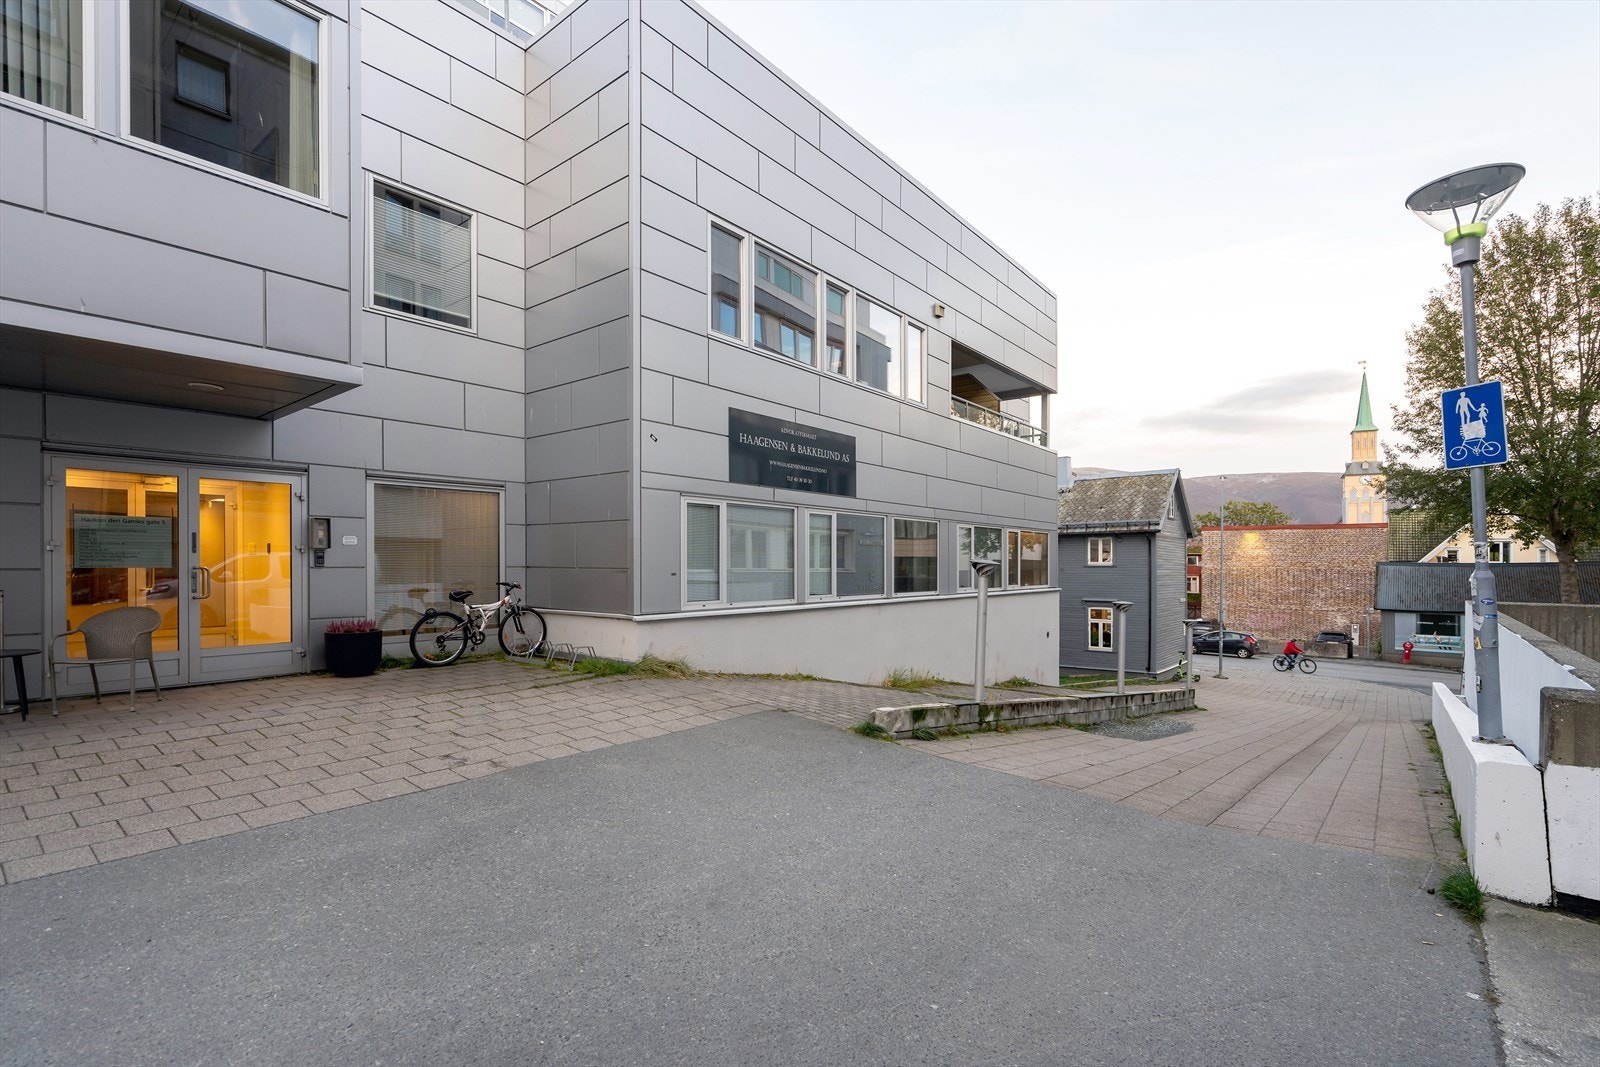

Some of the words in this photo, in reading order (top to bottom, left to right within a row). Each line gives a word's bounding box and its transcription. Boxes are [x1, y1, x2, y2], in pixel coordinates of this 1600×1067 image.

[739, 432, 788, 450] HAAGENSEN
[790, 443, 796, 453] &
[797, 444, 840, 461] BAKKELUND
[841, 454, 850, 463] AS
